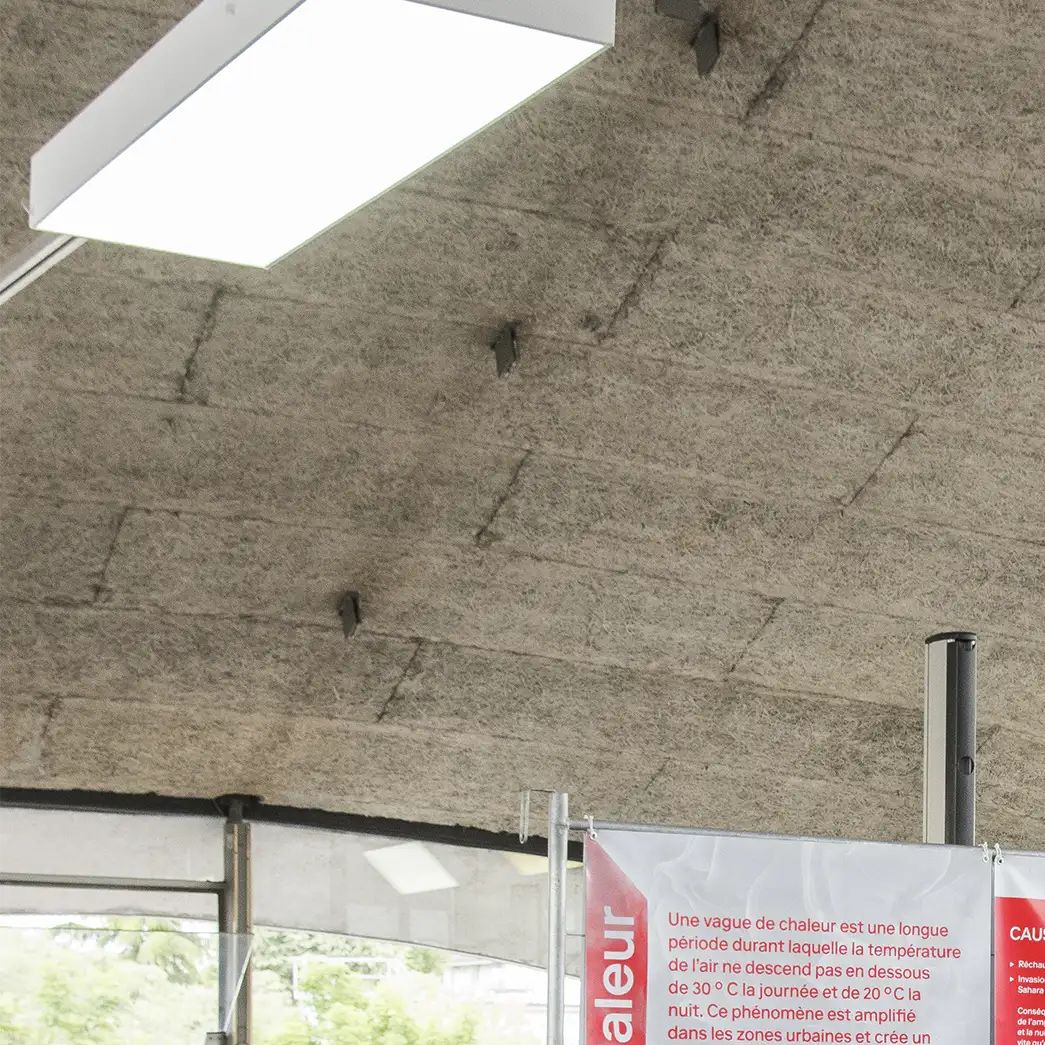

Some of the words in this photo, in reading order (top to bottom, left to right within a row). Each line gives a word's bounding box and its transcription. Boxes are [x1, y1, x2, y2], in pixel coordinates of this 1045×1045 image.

[668, 911, 700, 928] Une
[703, 916, 752, 932] vague
[755, 915, 775, 931] de
[778, 916, 836, 933] chaleur
[839, 920, 864, 934] est
[867, 923, 895, 935] une
[899, 921, 948, 940] longue
[668, 935, 728, 952] période
[731, 937, 785, 953] durant
[788, 939, 848, 957] laquelle
[851, 941, 864, 956] la
[867, 943, 961, 960] température
[1018, 986, 1044, 994] Sahara
[668, 1003, 703, 1018] nuit.
[706, 1003, 728, 1018] Ce
[731, 1004, 824, 1022] phénomène
[826, 1008, 851, 1021] est
[854, 1008, 916, 1025] amplifié
